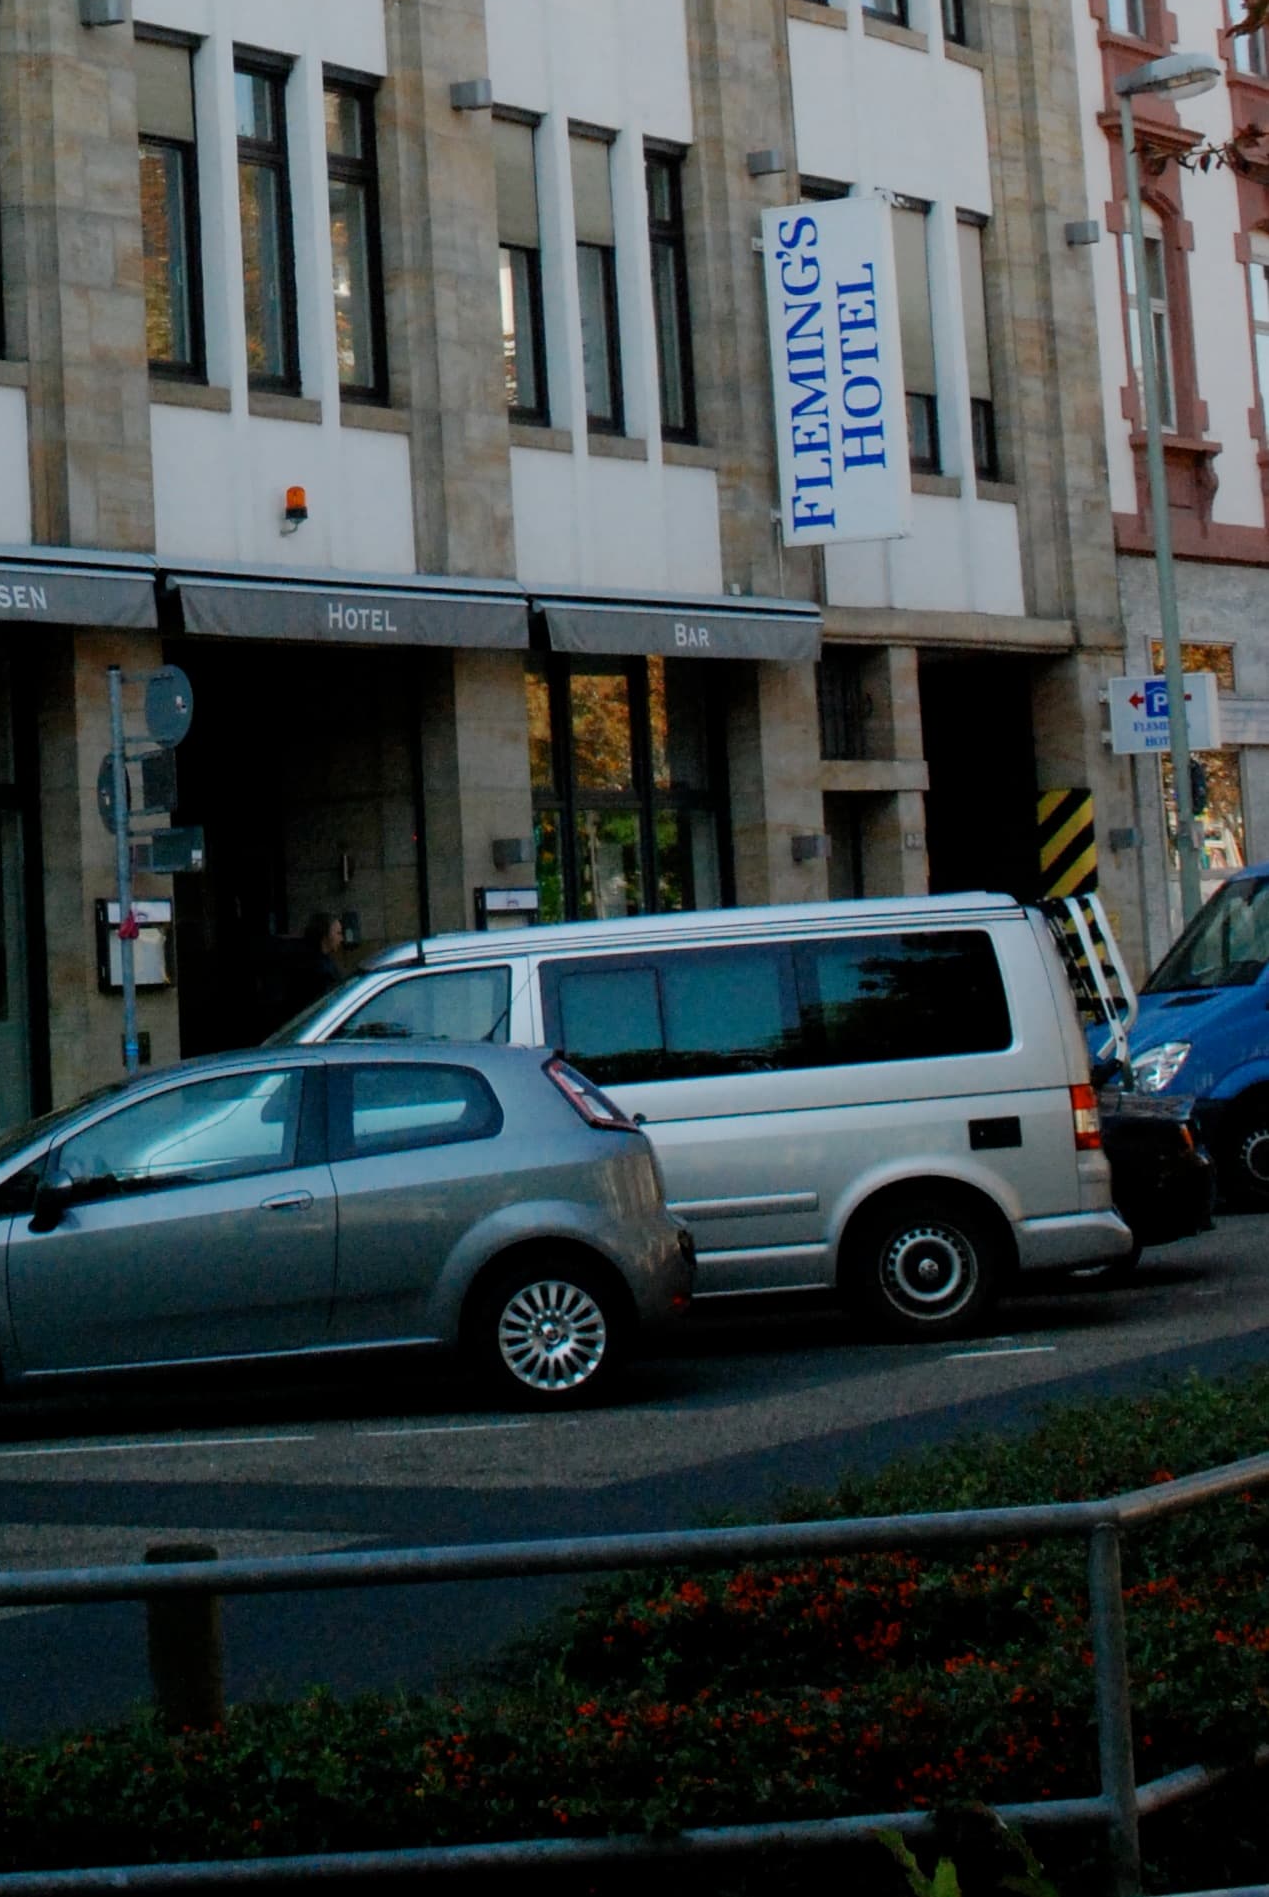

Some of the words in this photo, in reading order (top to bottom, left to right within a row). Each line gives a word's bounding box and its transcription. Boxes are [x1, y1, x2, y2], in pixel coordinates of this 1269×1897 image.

[775, 216, 836, 532] FLEMING'S
[836, 262, 886, 472] HOTEL
[328, 602, 397, 632] HOTEL
[674, 623, 710, 647] BAR
[1153, 692, 1168, 713] P
